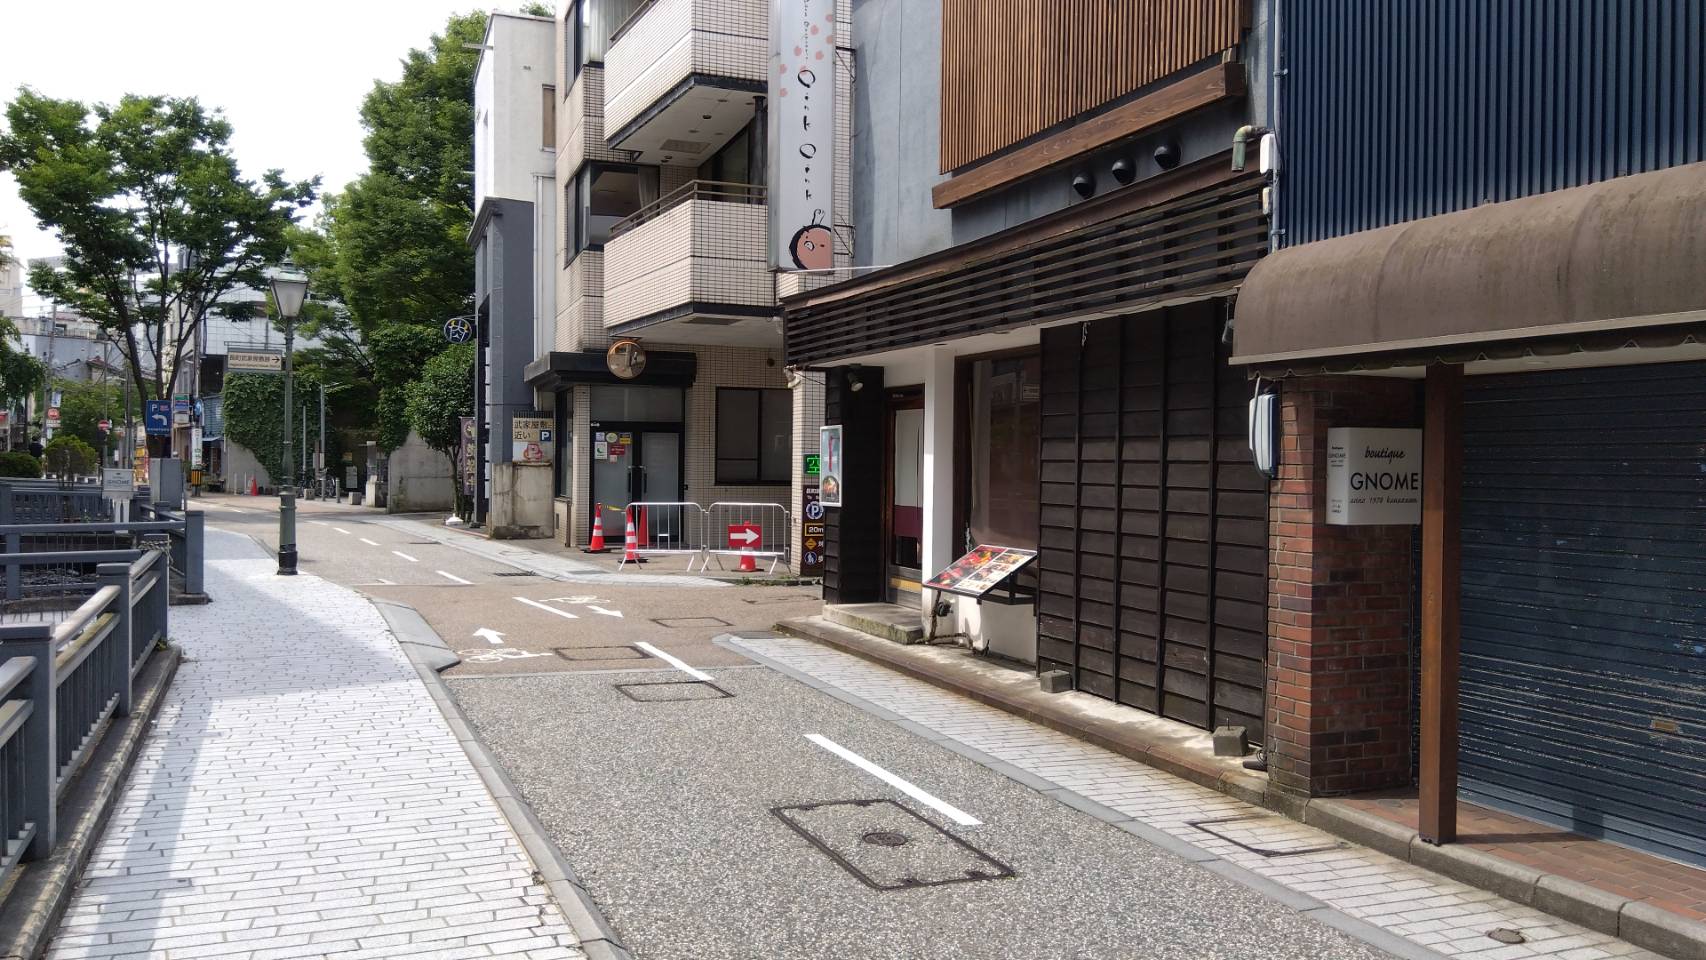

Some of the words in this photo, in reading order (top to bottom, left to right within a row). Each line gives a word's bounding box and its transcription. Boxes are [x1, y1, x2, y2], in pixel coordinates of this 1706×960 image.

[798, 70, 815, 131] Oink
[800, 143, 816, 200] Oink
[541, 431, 550, 441] P
[1364, 445, 1406, 464] boutique
[1350, 472, 1419, 490] GNOME
[811, 505, 819, 517] P
